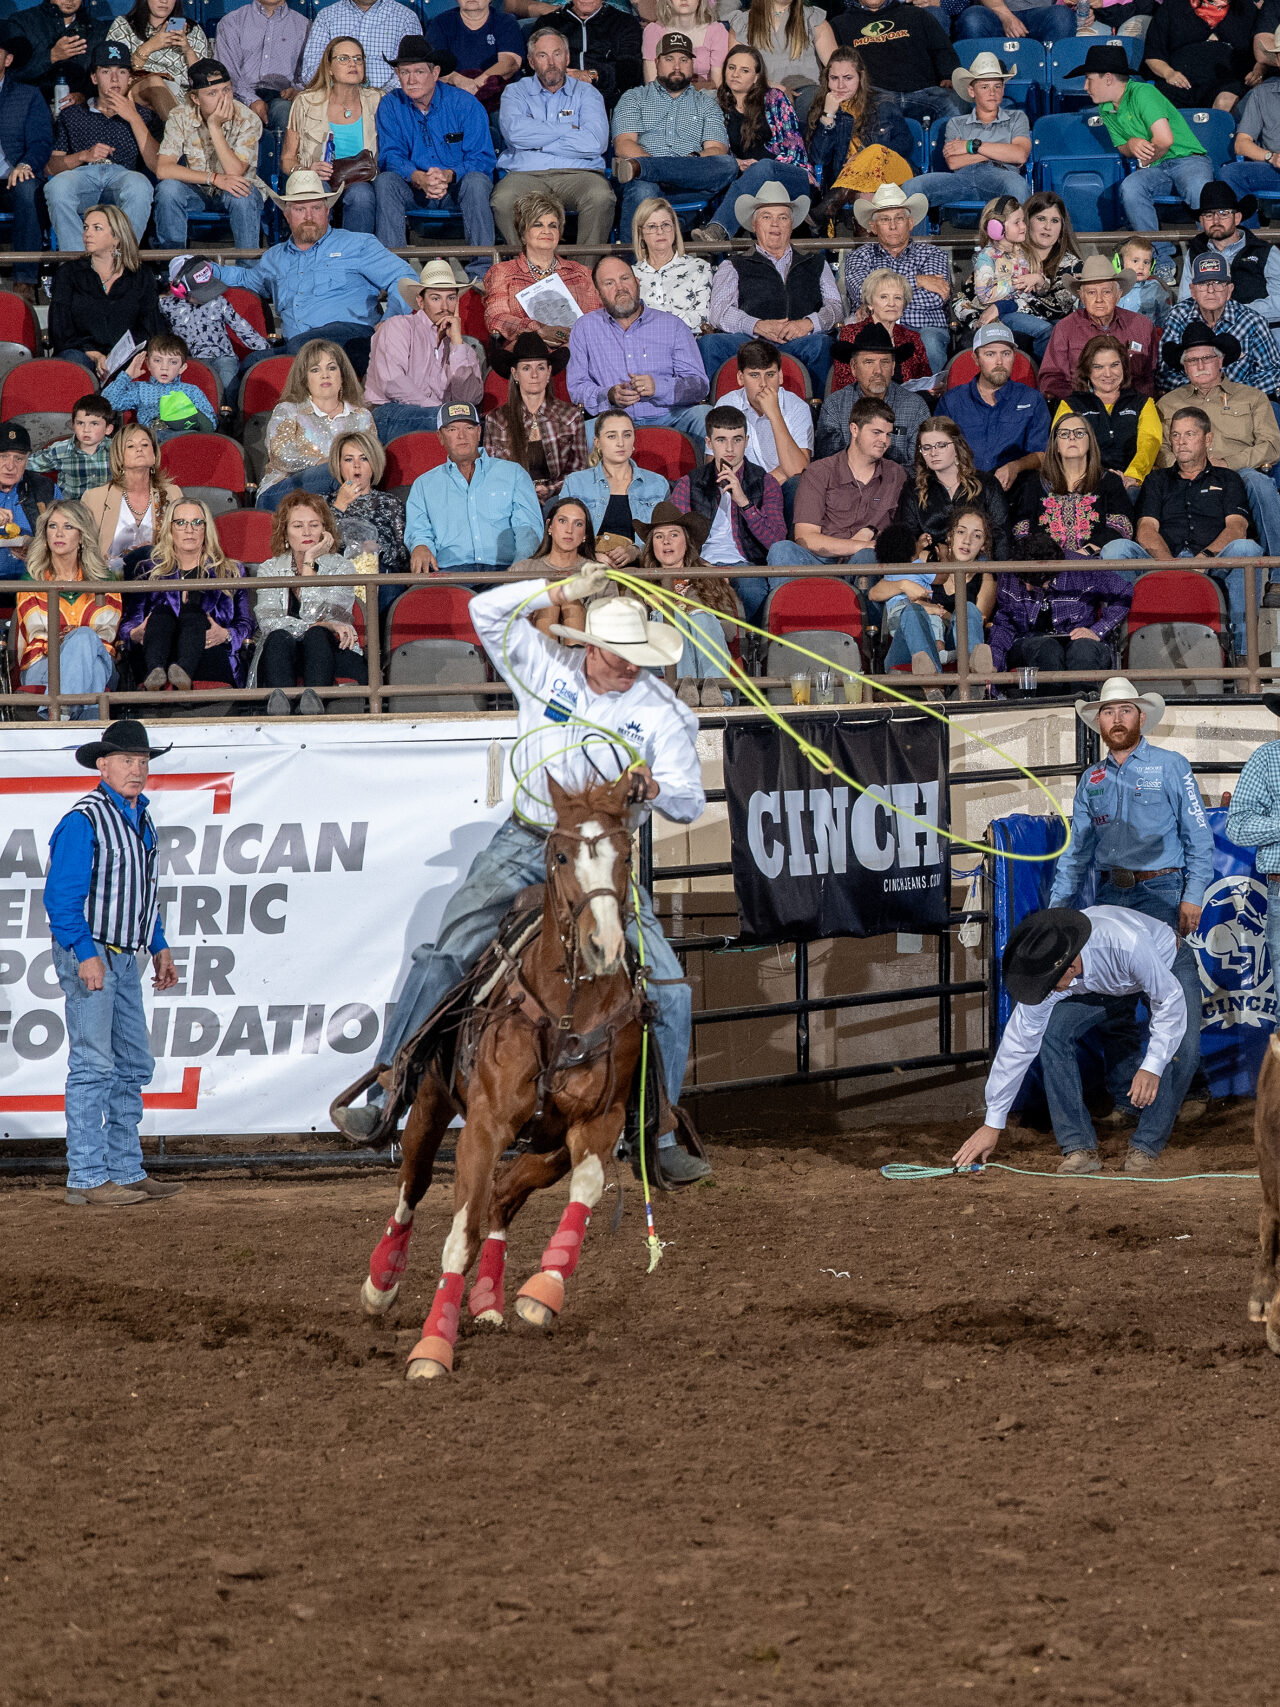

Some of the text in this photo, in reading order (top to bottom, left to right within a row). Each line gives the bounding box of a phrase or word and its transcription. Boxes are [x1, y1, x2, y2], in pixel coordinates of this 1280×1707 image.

[887, 29, 910, 40] OAK
[1136, 777, 1162, 788] Classic
[1182, 771, 1208, 829] Wrangler
[0, 821, 369, 879] ARICAN
[747, 780, 940, 879] CINCH
[0, 945, 236, 1000] POER
[0, 1002, 398, 1061] ODATIO
[1202, 995, 1278, 1019] CINCH
